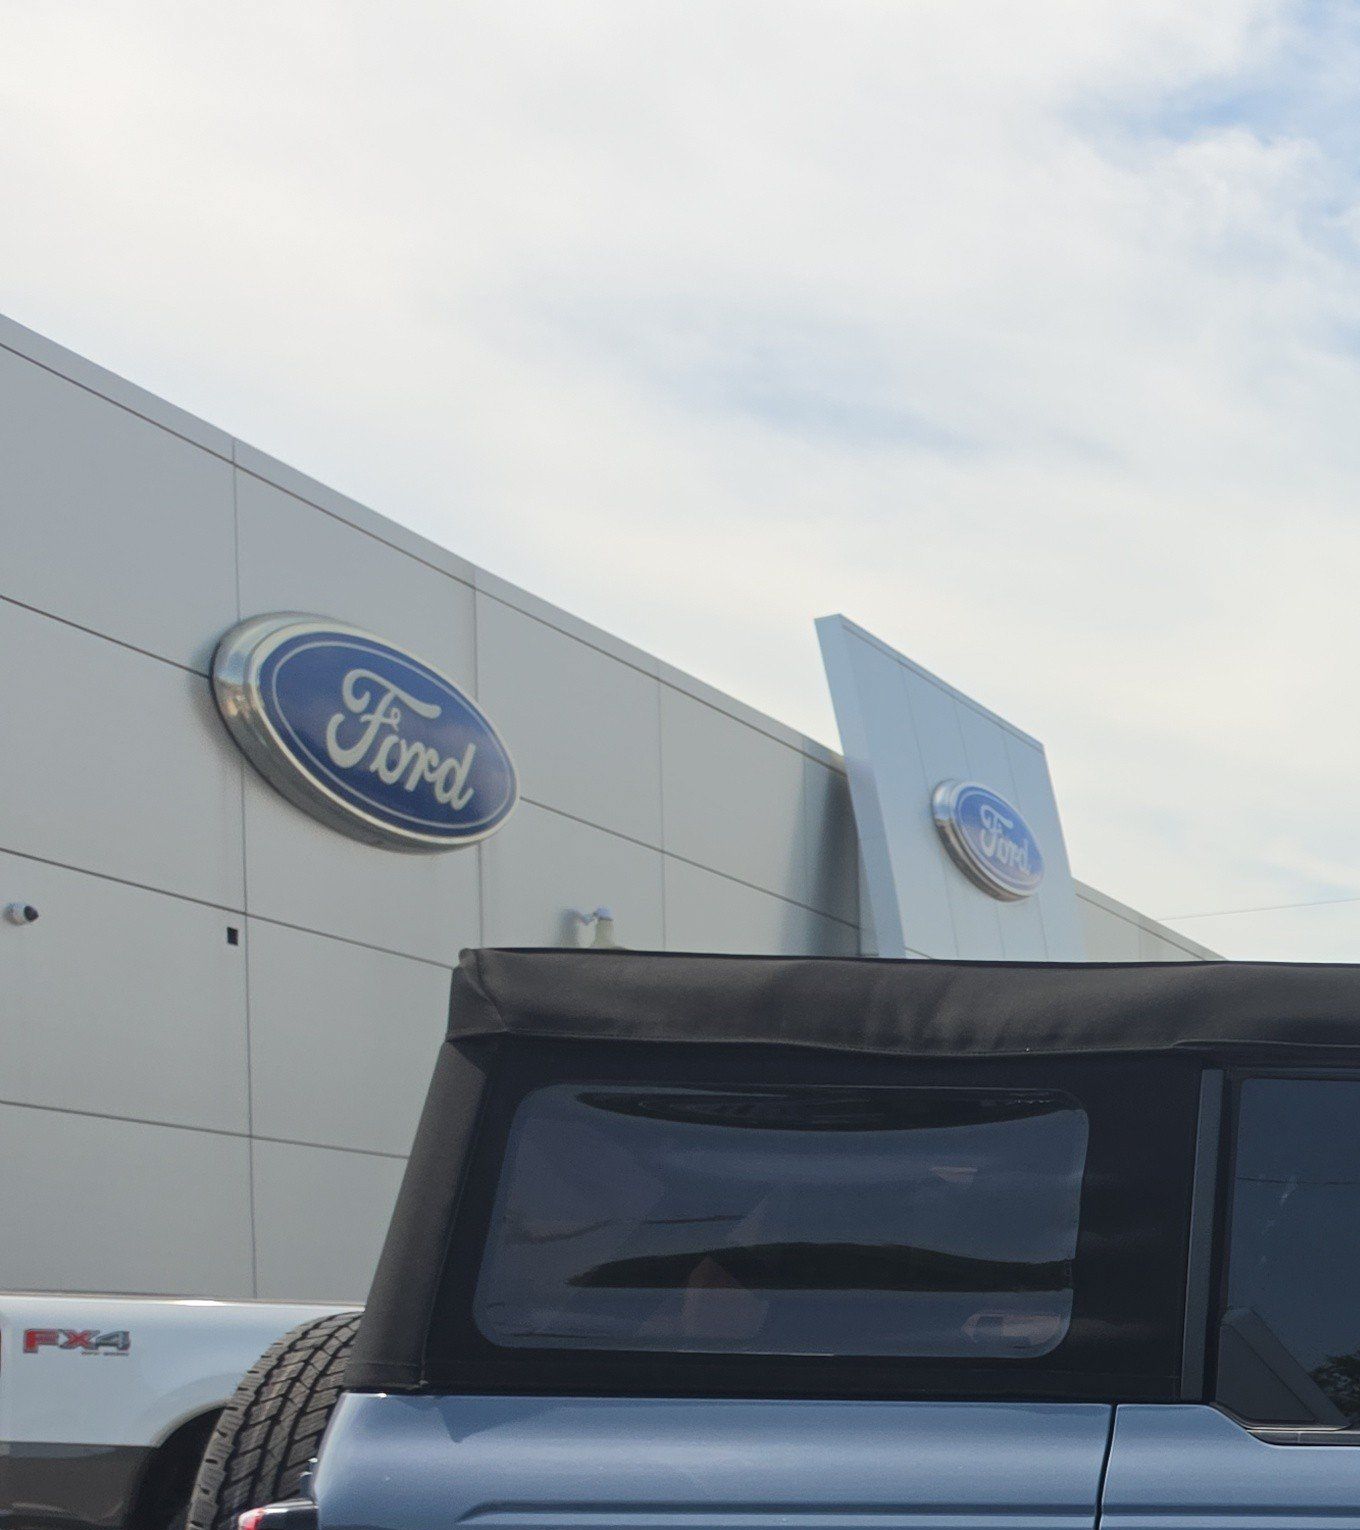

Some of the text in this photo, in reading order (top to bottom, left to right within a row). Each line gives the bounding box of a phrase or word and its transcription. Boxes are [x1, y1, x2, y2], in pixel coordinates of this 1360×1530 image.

[325, 668, 475, 810] Ford
[979, 804, 1032, 873] Ford
[23, 1329, 130, 1353] FX4
